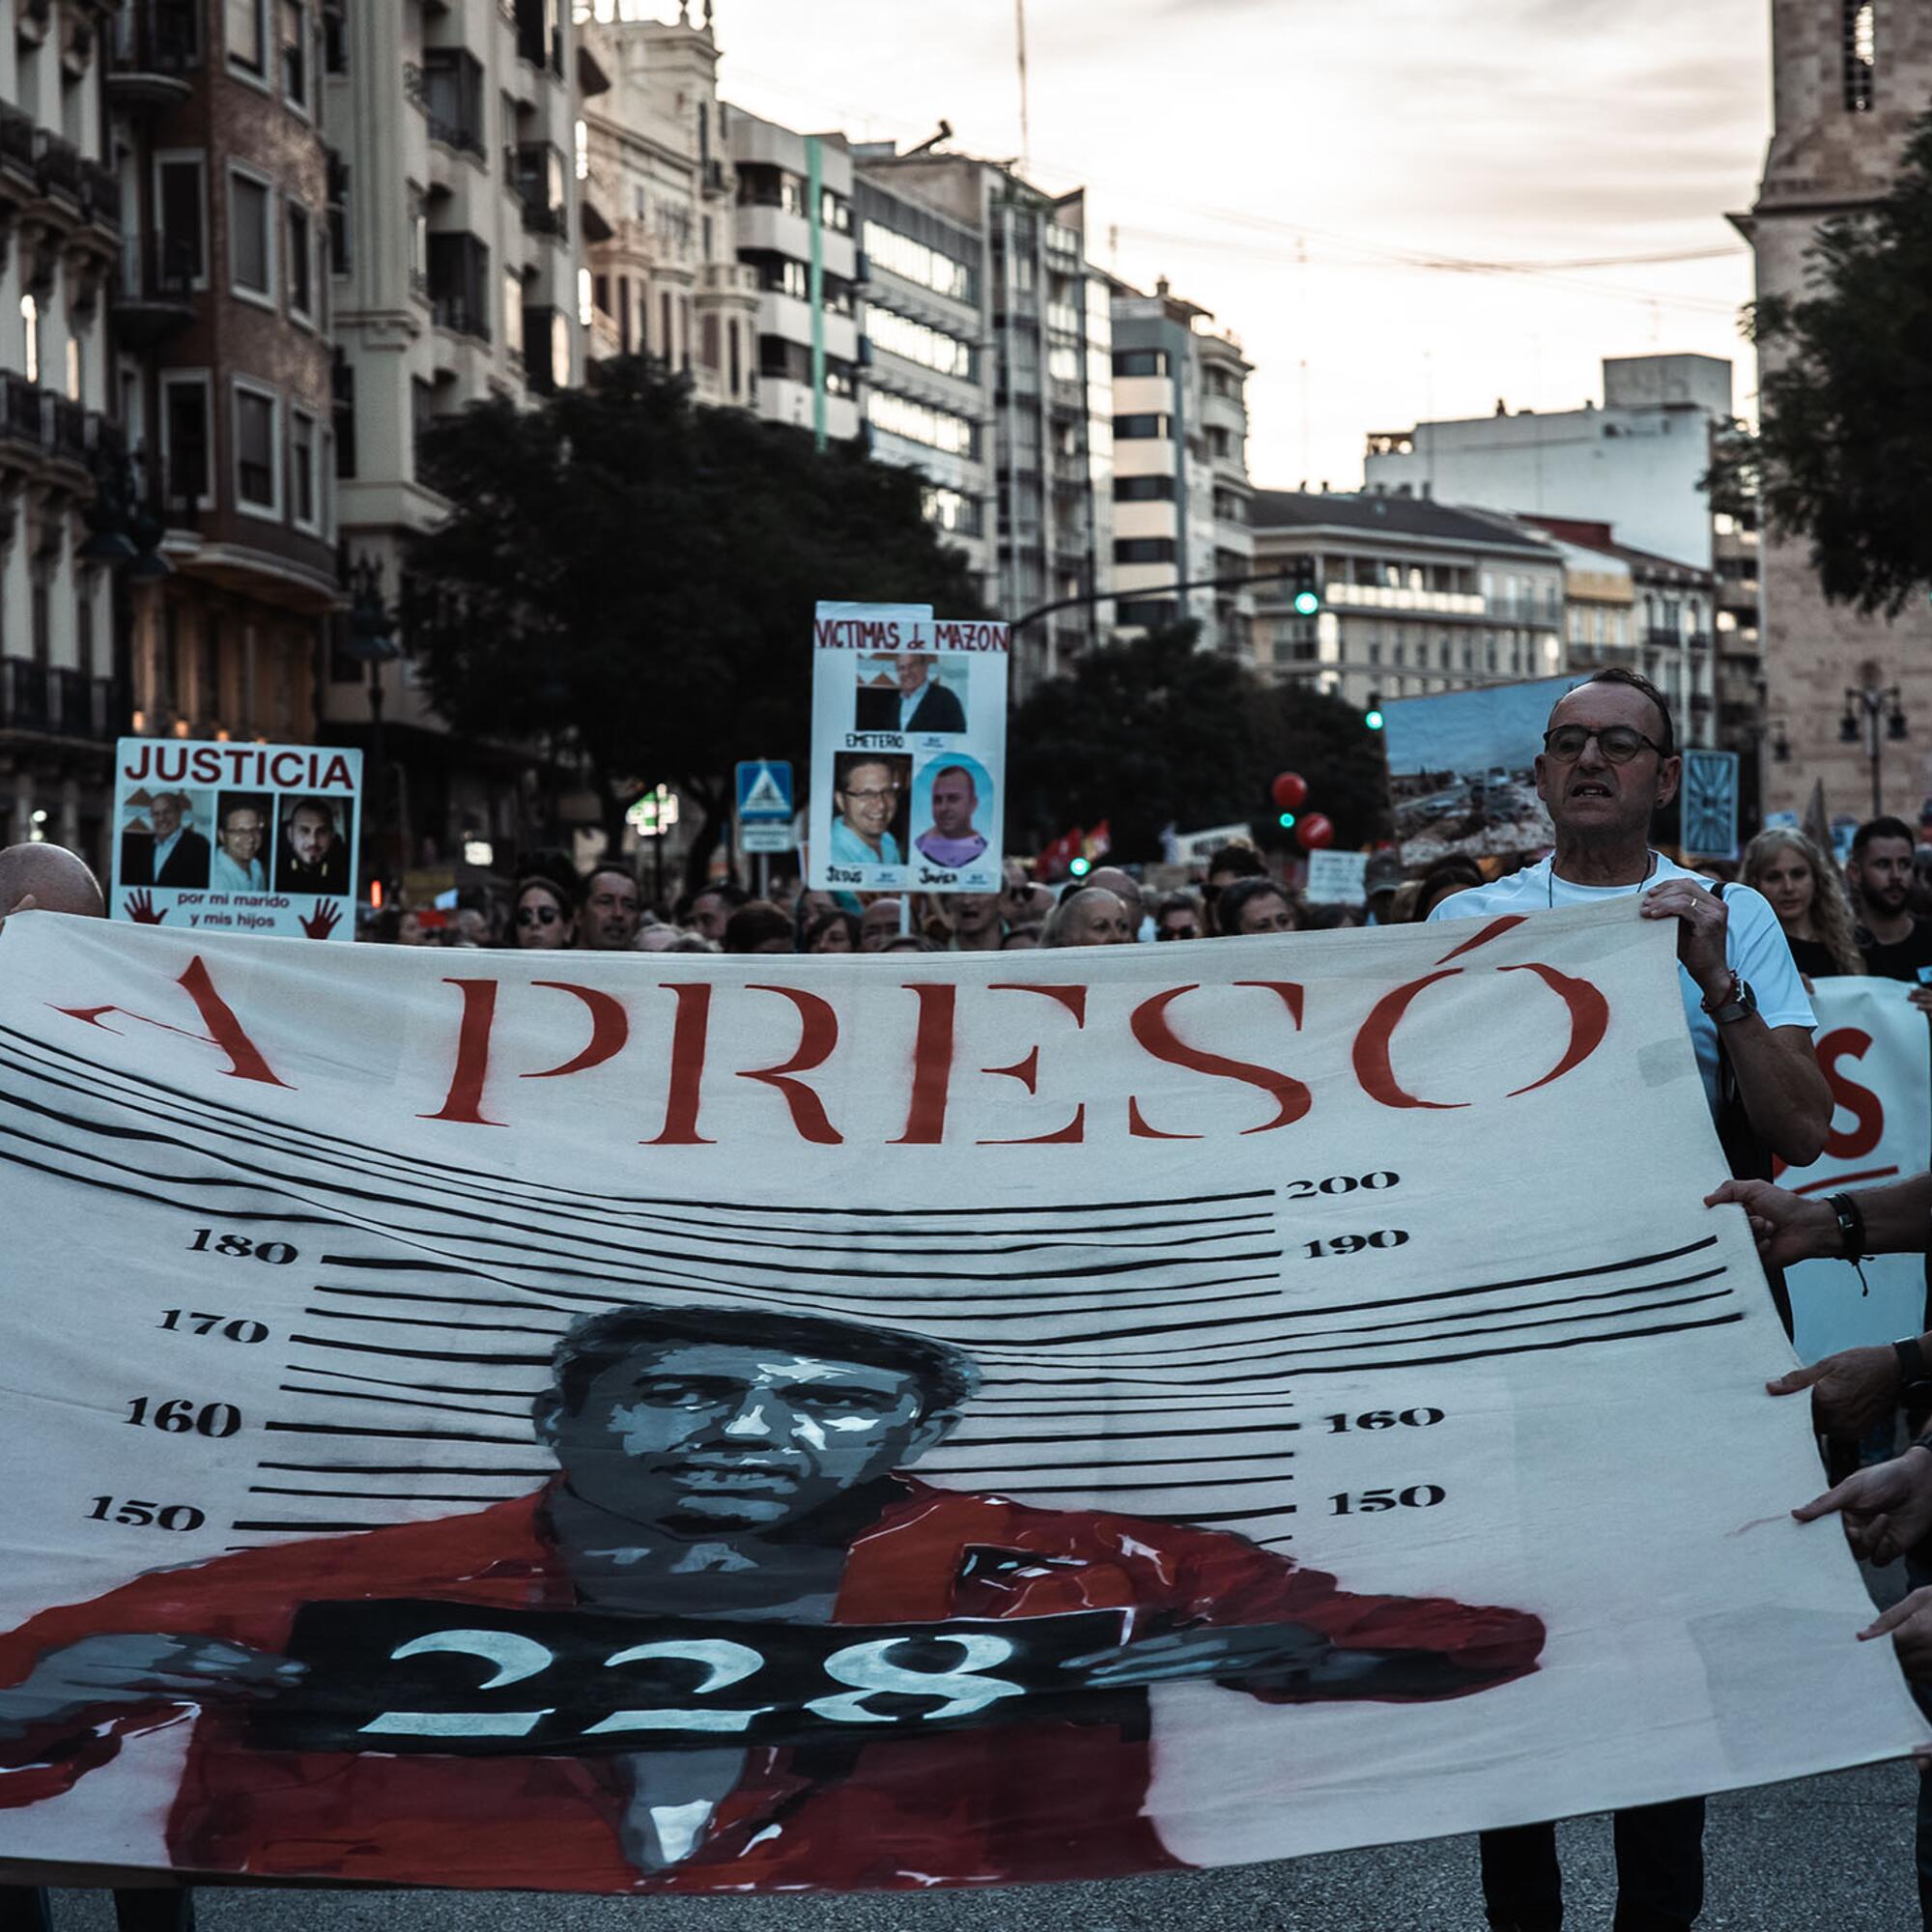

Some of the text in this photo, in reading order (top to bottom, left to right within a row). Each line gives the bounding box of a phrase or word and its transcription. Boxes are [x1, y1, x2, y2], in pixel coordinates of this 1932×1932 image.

[814, 619, 900, 650] VICTIMAS
[845, 733, 904, 749] EMETERIO
[124, 746, 355, 789] JUSTICIA
[178, 893, 290, 909] por mi marido
[190, 912, 275, 928] y mis hijos
[44, 916, 1610, 1146] A PRESÓ
[1287, 1171, 1401, 1200] 200
[185, 1228, 299, 1265] 180
[1302, 1229, 1410, 1260] 190
[155, 1309, 270, 1345] 170
[123, 1397, 242, 1438] 160
[1323, 1406, 1445, 1435] 160
[83, 1495, 206, 1532] 150
[1328, 1484, 1446, 1516] 150
[357, 1629, 1026, 1737] 228
